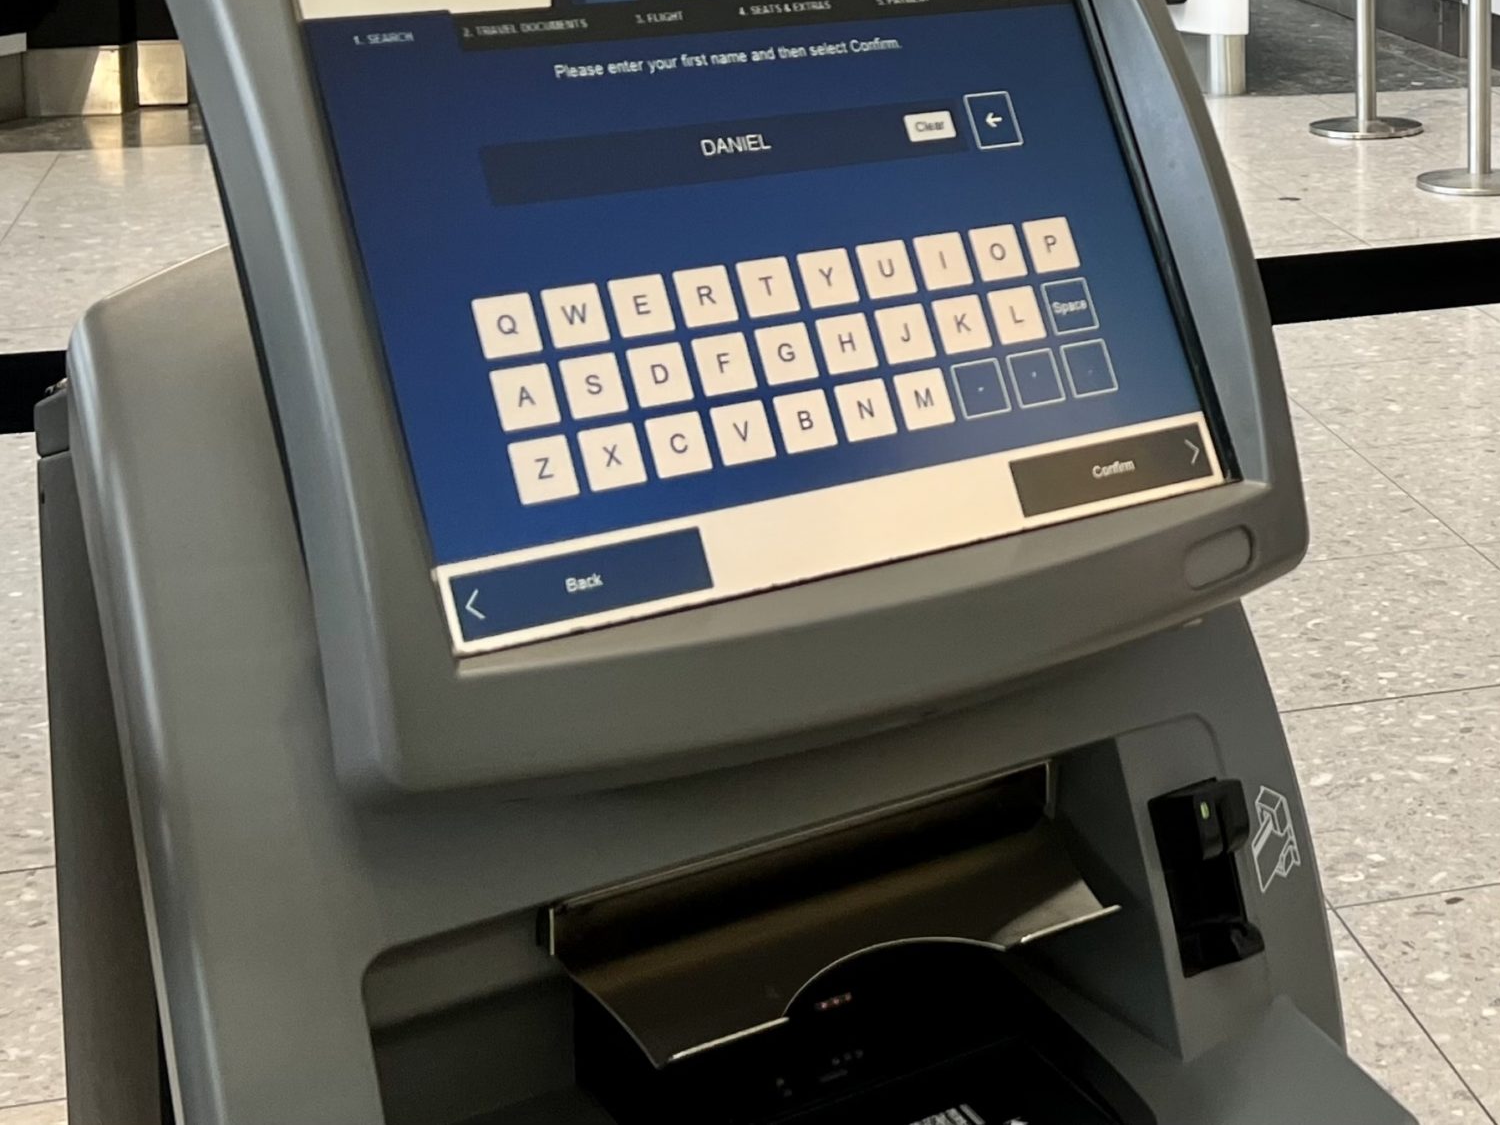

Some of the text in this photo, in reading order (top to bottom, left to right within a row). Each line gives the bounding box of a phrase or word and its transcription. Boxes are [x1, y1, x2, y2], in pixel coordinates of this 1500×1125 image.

[647, 11, 684, 23] FLIGHT
[750, 4, 781, 15] SEATS
[793, 0, 831, 13] EXTRAS
[367, 31, 414, 44] SEARCH
[553, 64, 604, 79] Please
[607, 60, 643, 74] enter
[645, 57, 678, 74] your
[680, 53, 709, 67] first
[710, 51, 747, 65] name
[751, 47, 775, 62] and
[777, 45, 807, 59] then
[809, 41, 848, 57] select
[914, 117, 945, 133] Clear
[701, 134, 772, 157] DANIEL
[496, 314, 519, 336] Q
[560, 302, 587, 326] W
[632, 294, 652, 316] E
[696, 285, 717, 306] R
[758, 275, 773, 297] T
[818, 266, 833, 287] Y
[877, 258, 895, 279] U
[989, 242, 1006, 261] O
[1043, 234, 1057, 252] P
[518, 299, 1088, 408] A S D F G H J K L Space
[534, 387, 934, 480] Z X C V B N M
[1092, 459, 1136, 479] Confirm
[565, 572, 603, 594] Back
